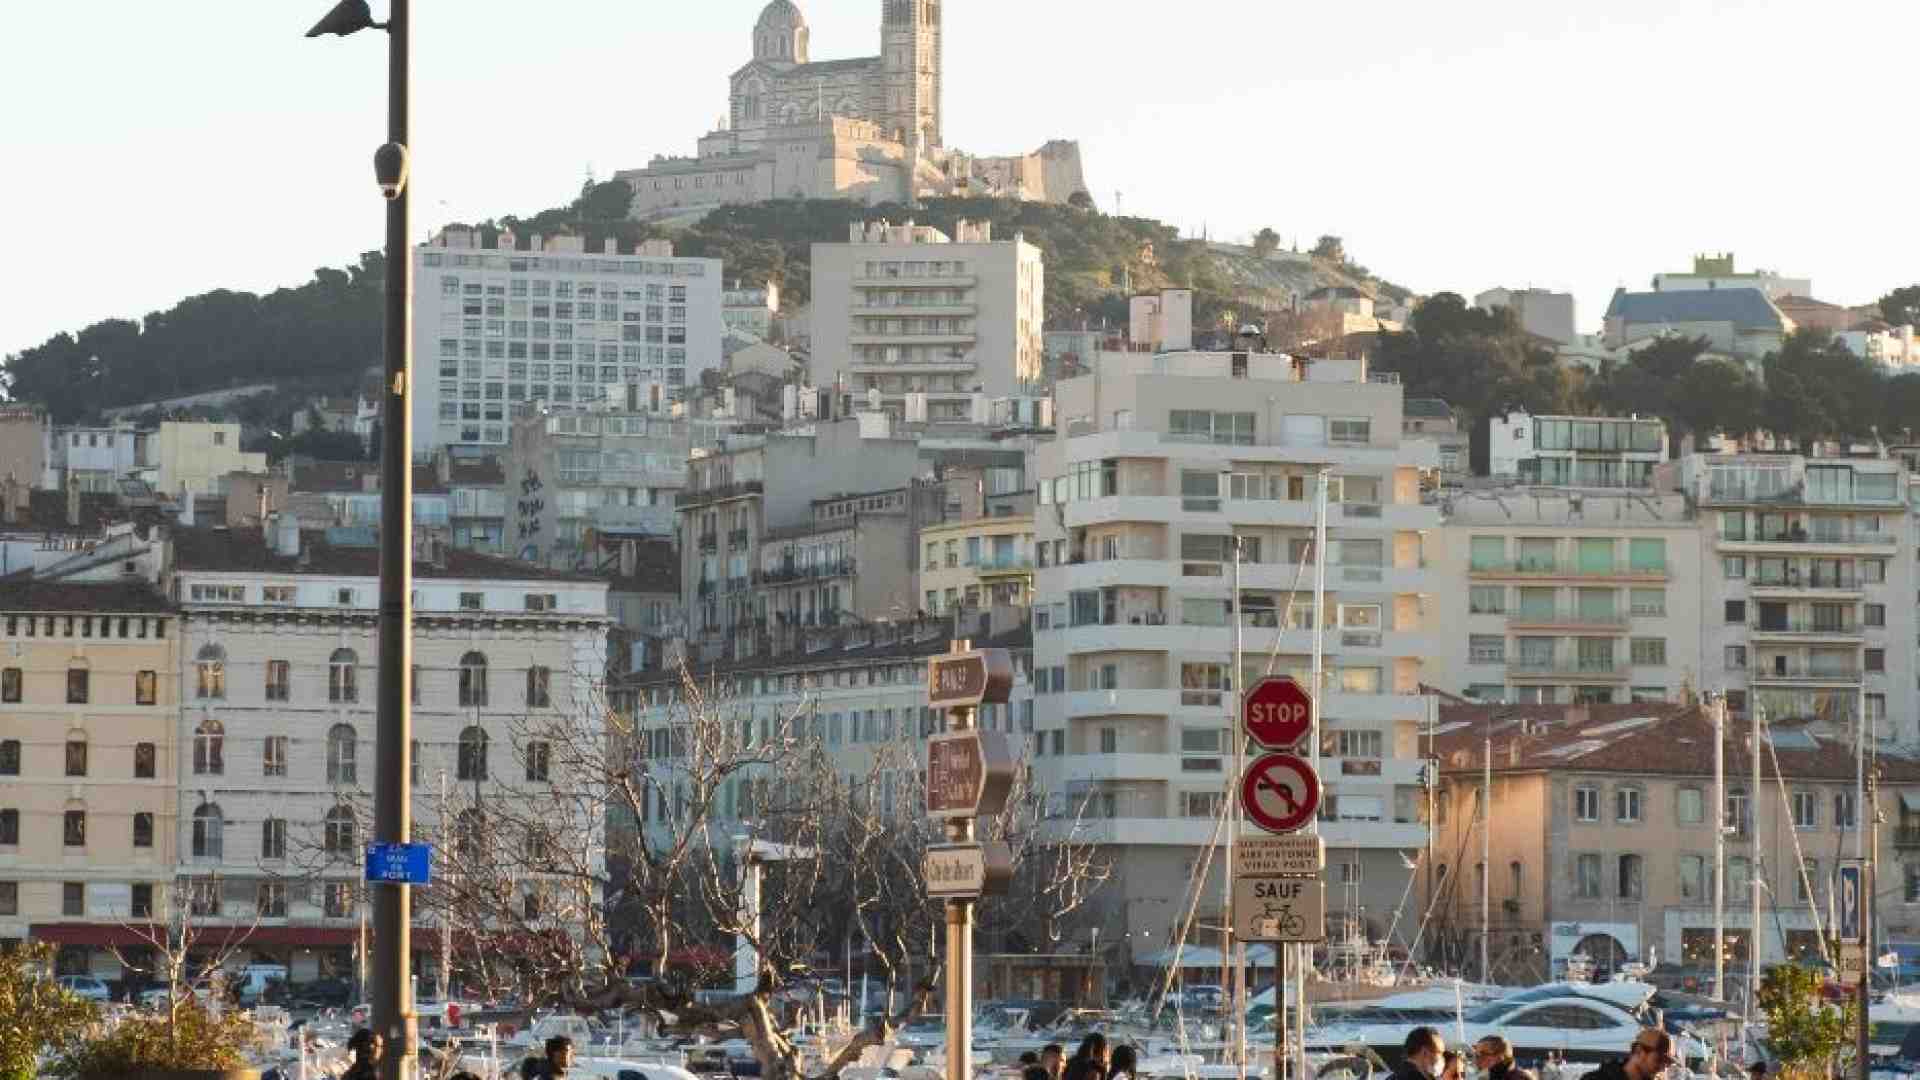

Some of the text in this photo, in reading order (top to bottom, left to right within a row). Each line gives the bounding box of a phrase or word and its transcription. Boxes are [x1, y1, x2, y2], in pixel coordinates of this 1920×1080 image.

[1250, 702, 1306, 723] STOP
[1244, 860, 1278, 870] VIEUX
[1254, 881, 1303, 898] SAUF
